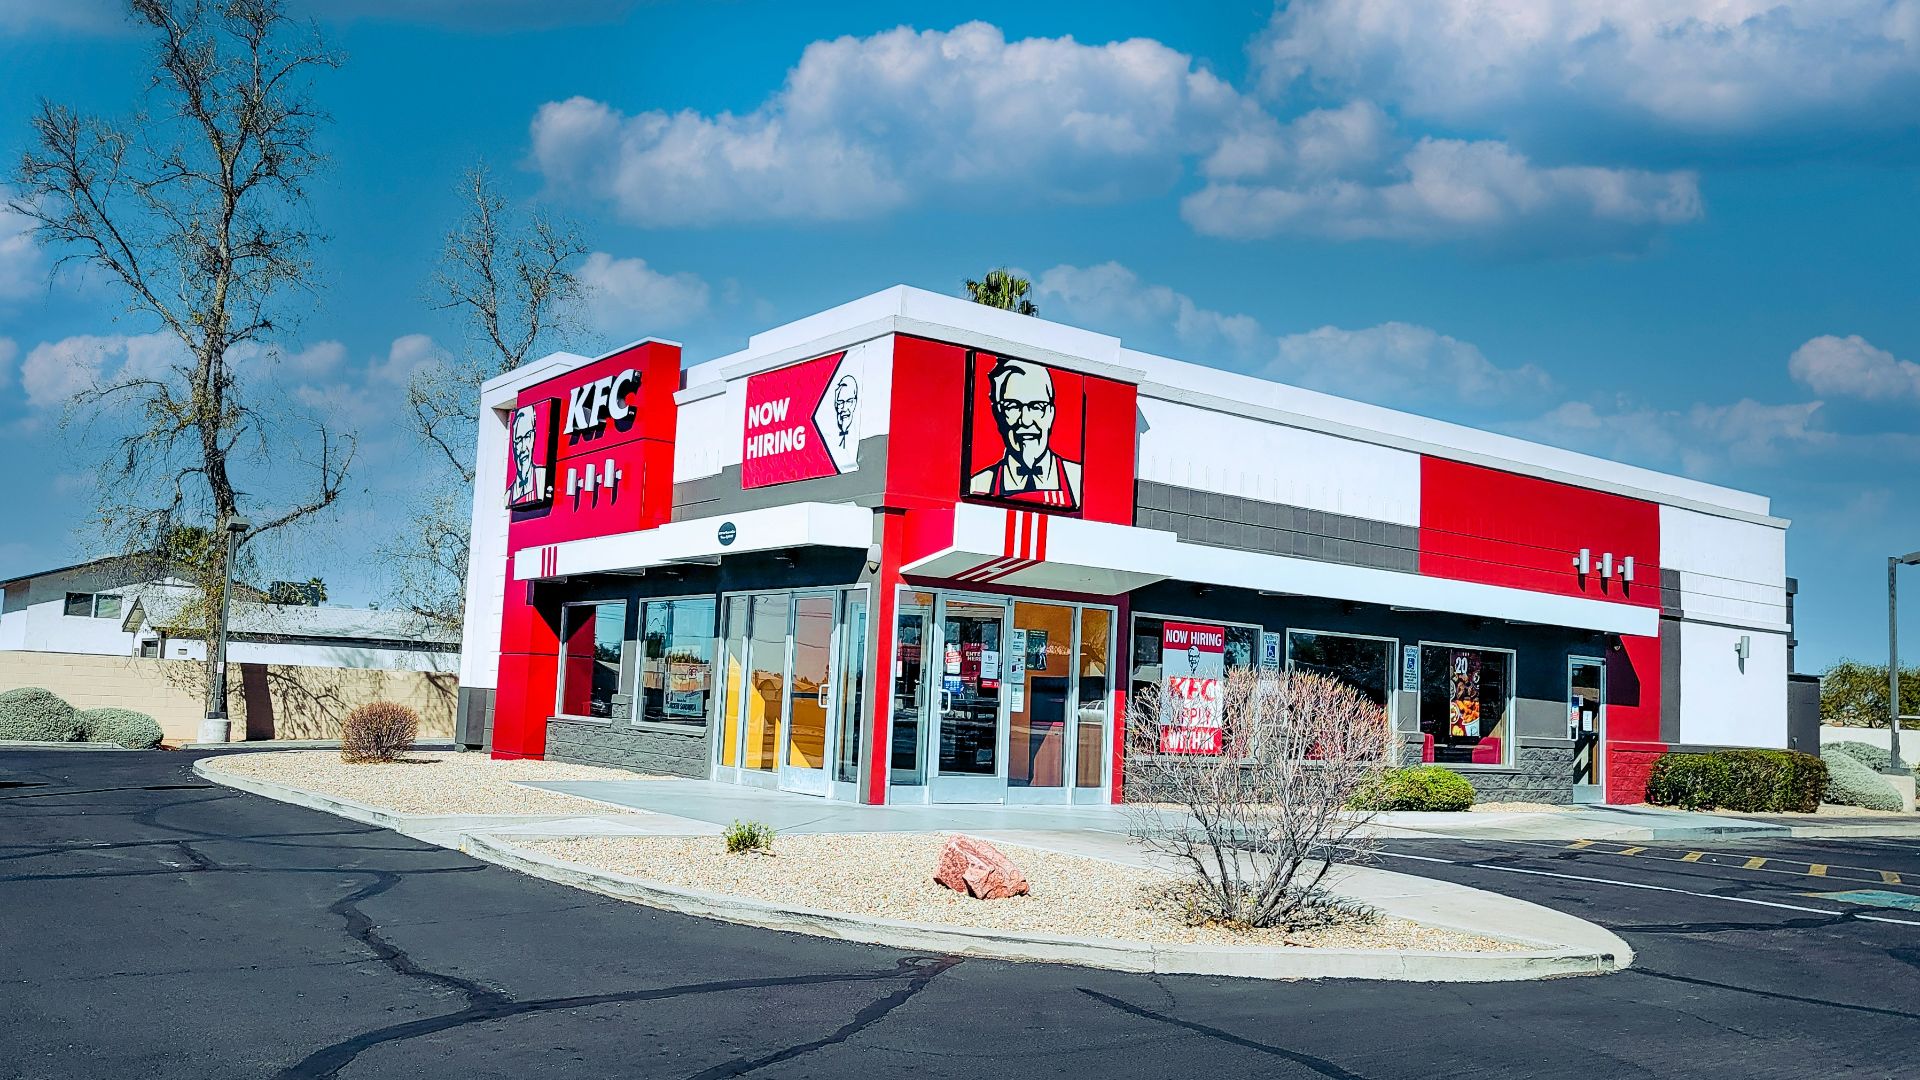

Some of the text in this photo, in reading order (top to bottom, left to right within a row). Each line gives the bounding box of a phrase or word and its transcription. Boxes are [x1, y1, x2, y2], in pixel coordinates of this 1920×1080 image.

[563, 368, 639, 435] KFC
[748, 396, 791, 430] NOW
[746, 425, 806, 460] HIRING
[1165, 629, 1222, 647] NOW HIRING
[1454, 656, 1468, 674] 20
[1167, 675, 1217, 702] KFC
